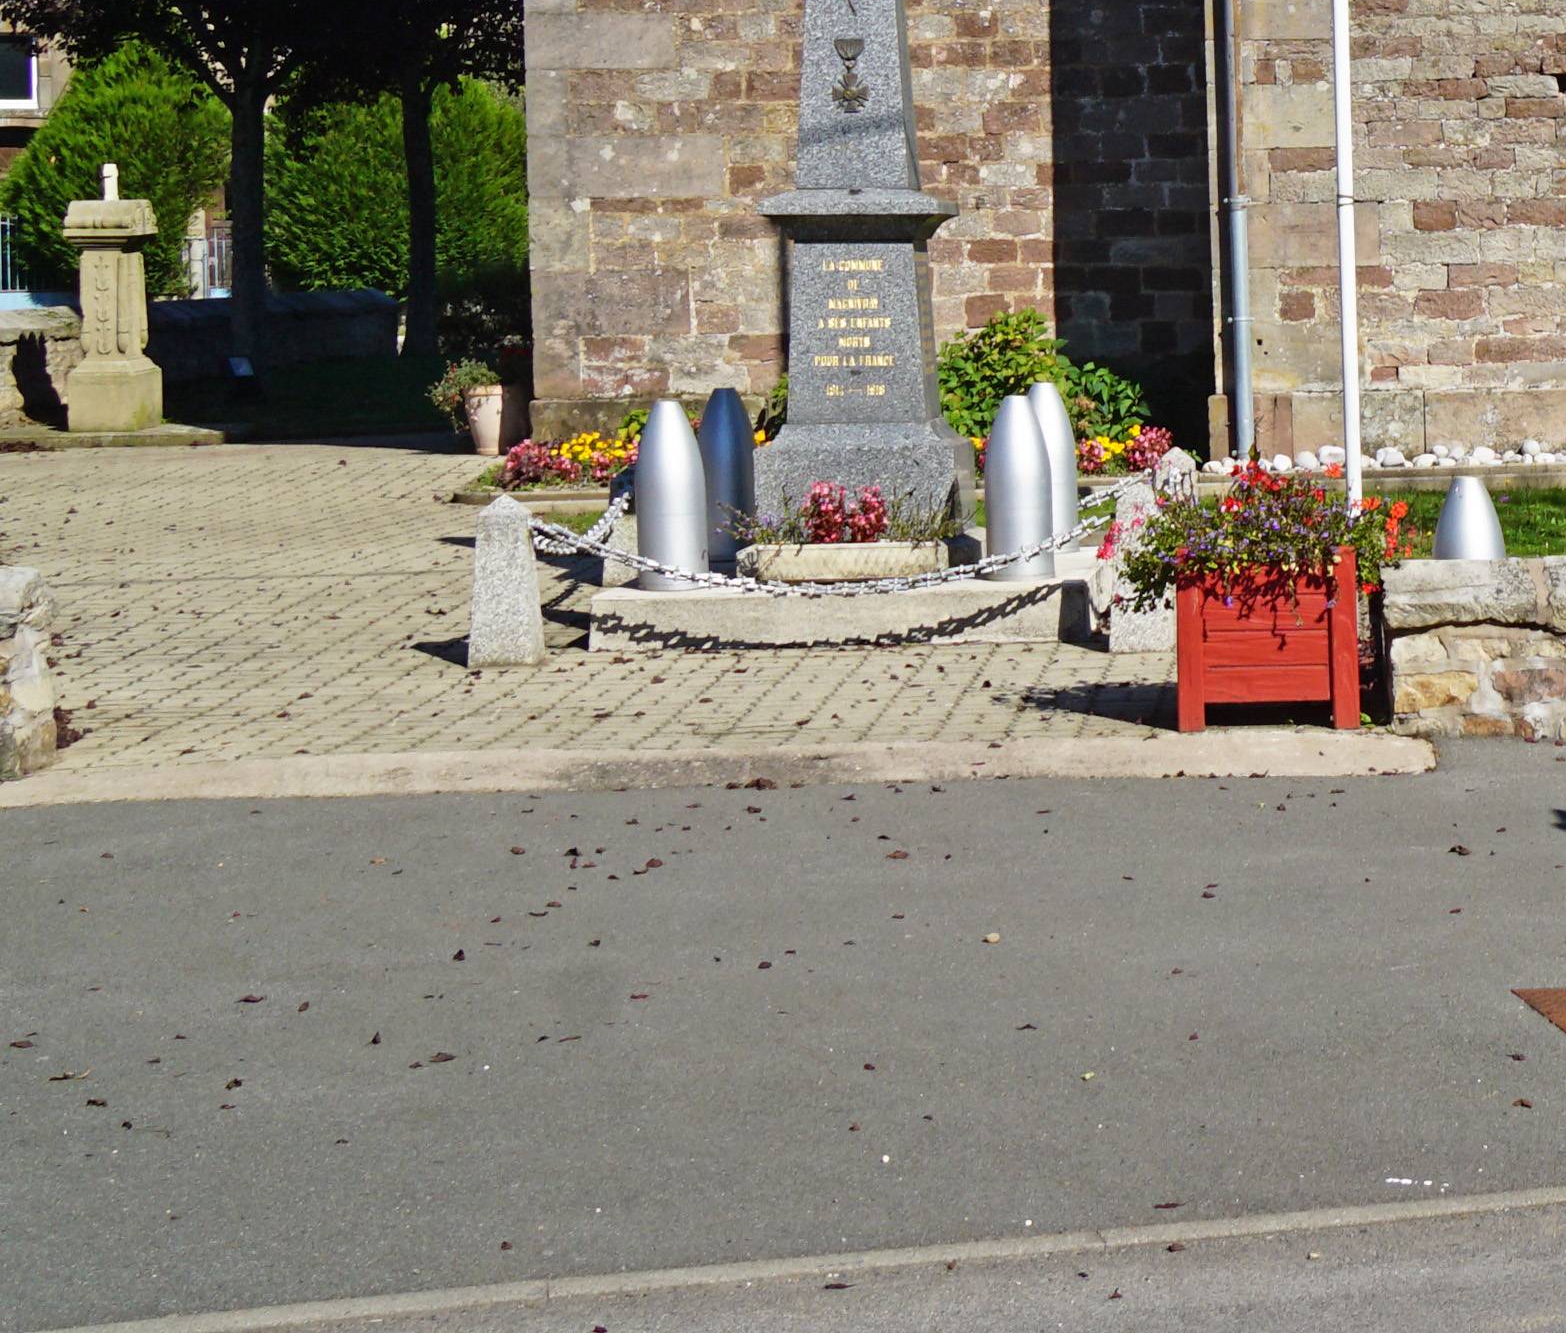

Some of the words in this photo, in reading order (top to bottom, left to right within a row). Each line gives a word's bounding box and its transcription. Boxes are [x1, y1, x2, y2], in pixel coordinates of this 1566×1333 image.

[850, 317, 892, 329] ENFANTS
[839, 336, 871, 348] MORTS
[814, 355, 839, 367] POUR
[843, 355, 856, 367] LA
[859, 355, 896, 367] FRANCE
